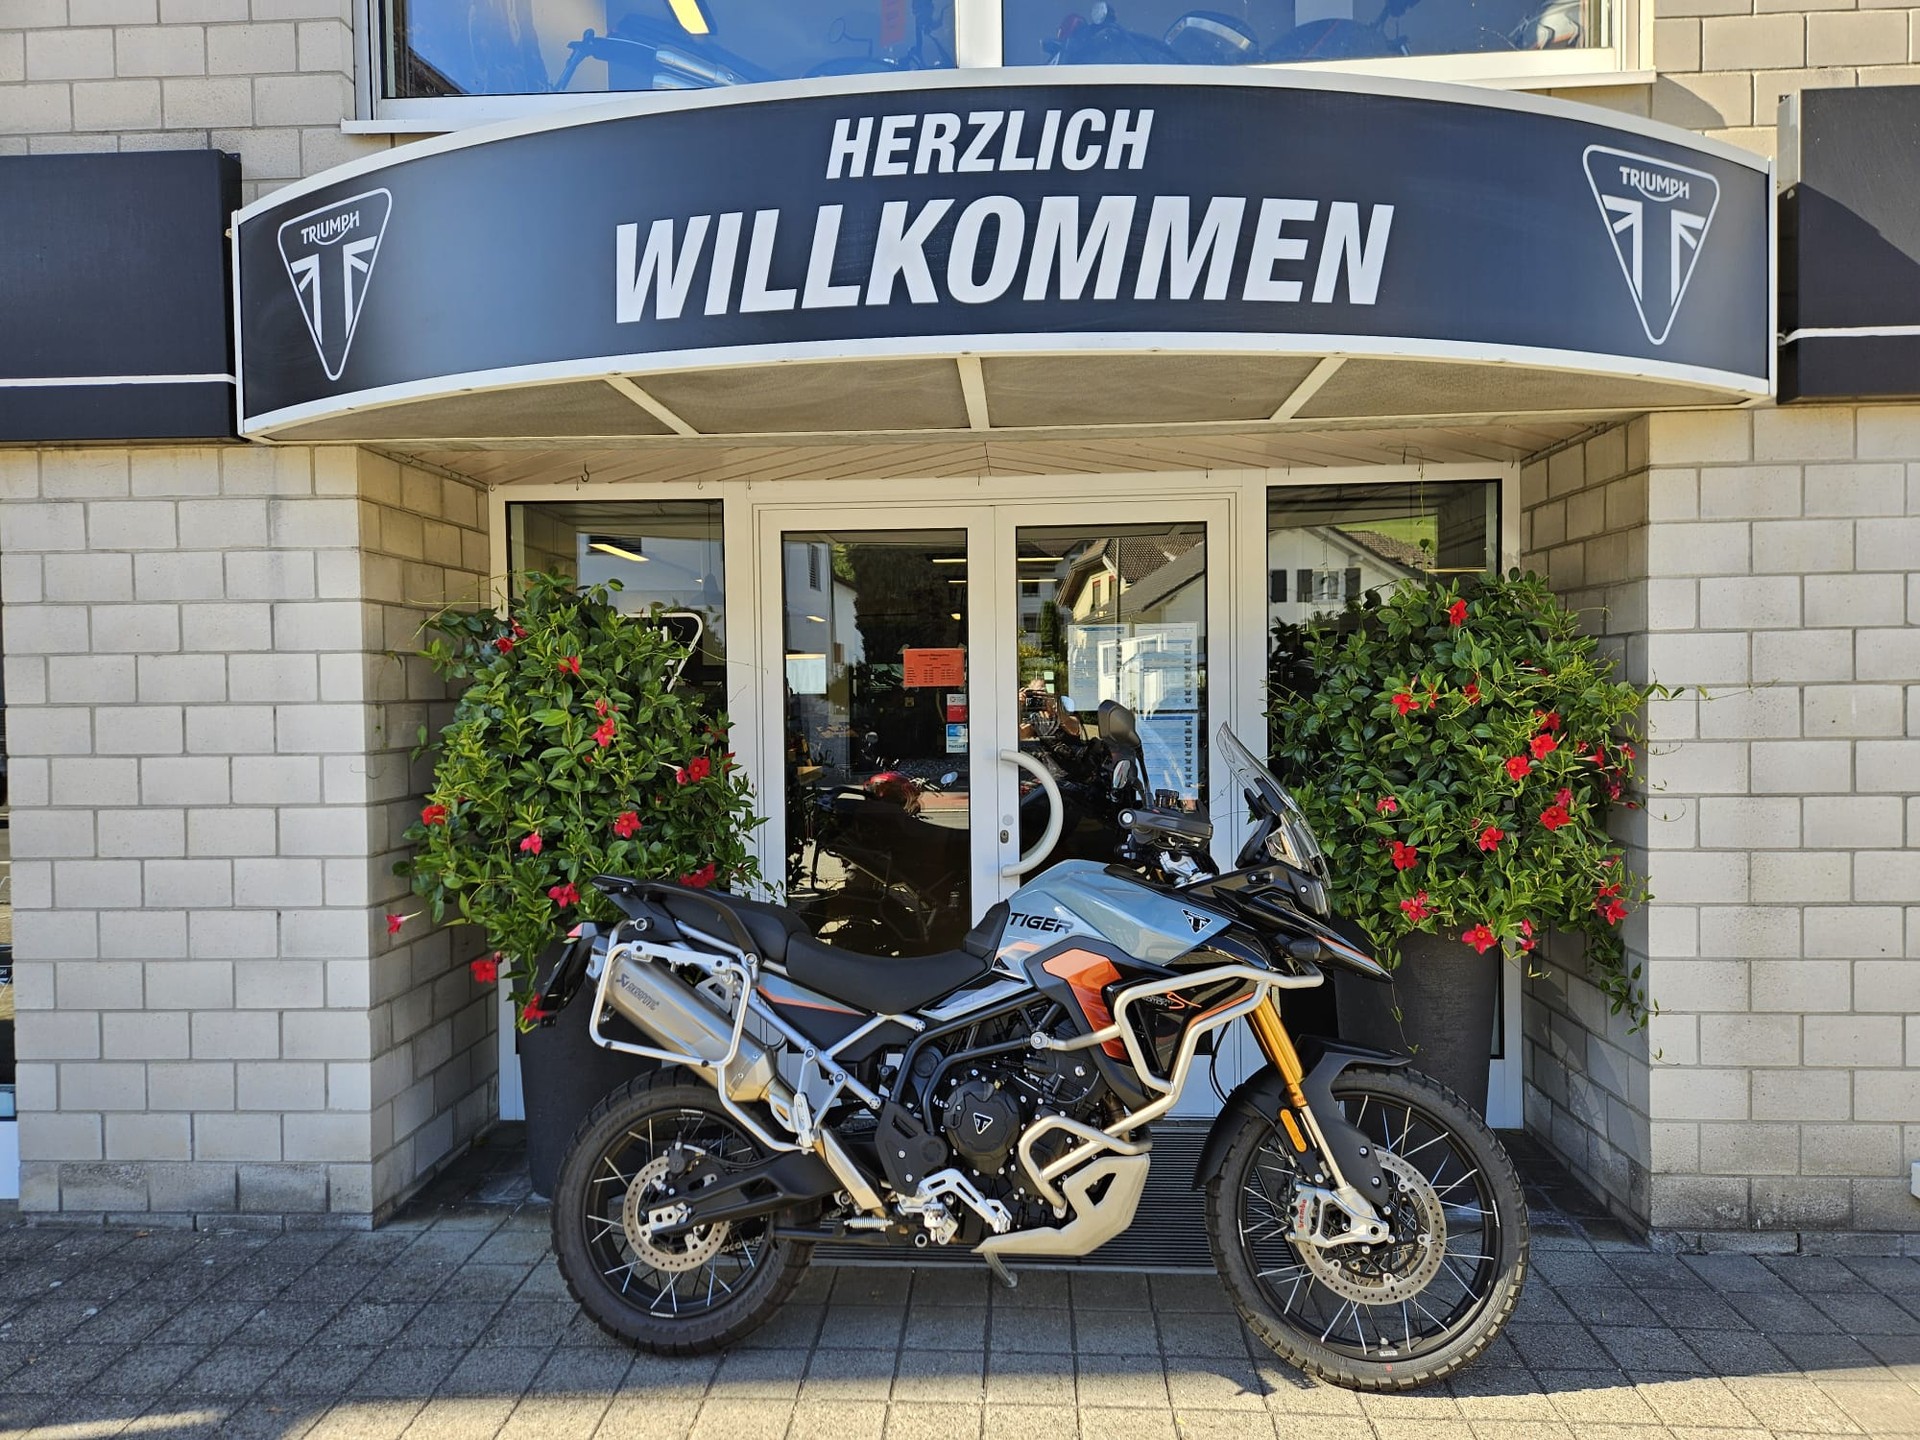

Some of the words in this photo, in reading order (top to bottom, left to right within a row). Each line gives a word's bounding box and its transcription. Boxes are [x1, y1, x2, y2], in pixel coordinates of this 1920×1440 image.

[826, 108, 1154, 179] HERZLICH
[1619, 166, 1690, 202] TRIUMPH
[301, 210, 360, 246] TRIUMPH
[616, 195, 1394, 323] WILLKOMMEN
[1009, 912, 1074, 934] TIGER
